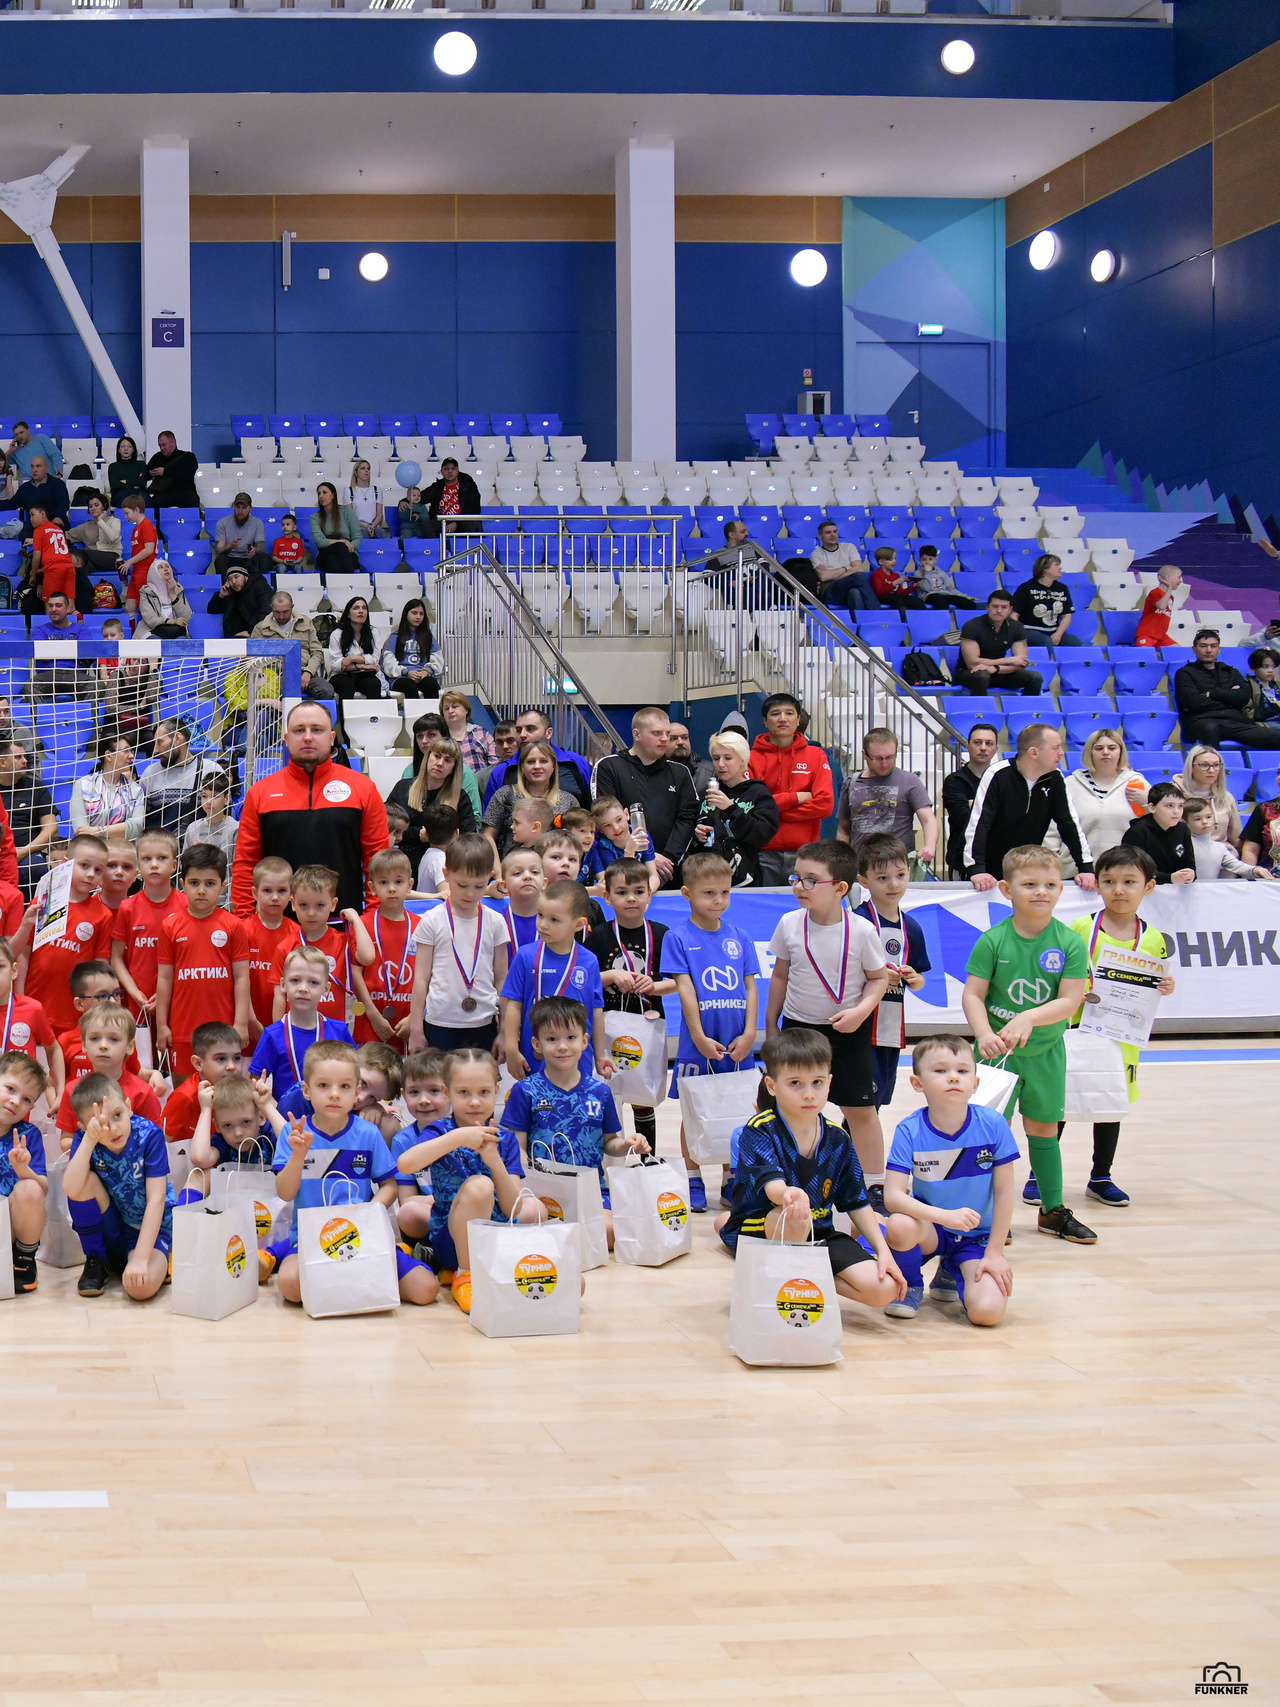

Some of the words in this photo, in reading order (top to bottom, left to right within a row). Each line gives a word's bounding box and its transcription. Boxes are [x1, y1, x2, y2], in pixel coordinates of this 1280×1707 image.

[50, 533, 69, 554] 13
[1102, 949, 1165, 974] ГРАМОТА
[177, 967, 228, 981] АРКТИКА
[1116, 973, 1144, 983] СЕМЕЧКА
[585, 1100, 602, 1117] 17
[321, 1222, 349, 1243] ТУРНИР
[519, 1263, 553, 1276] ТУРНИР
[783, 1289, 820, 1299] ТУРНИР
